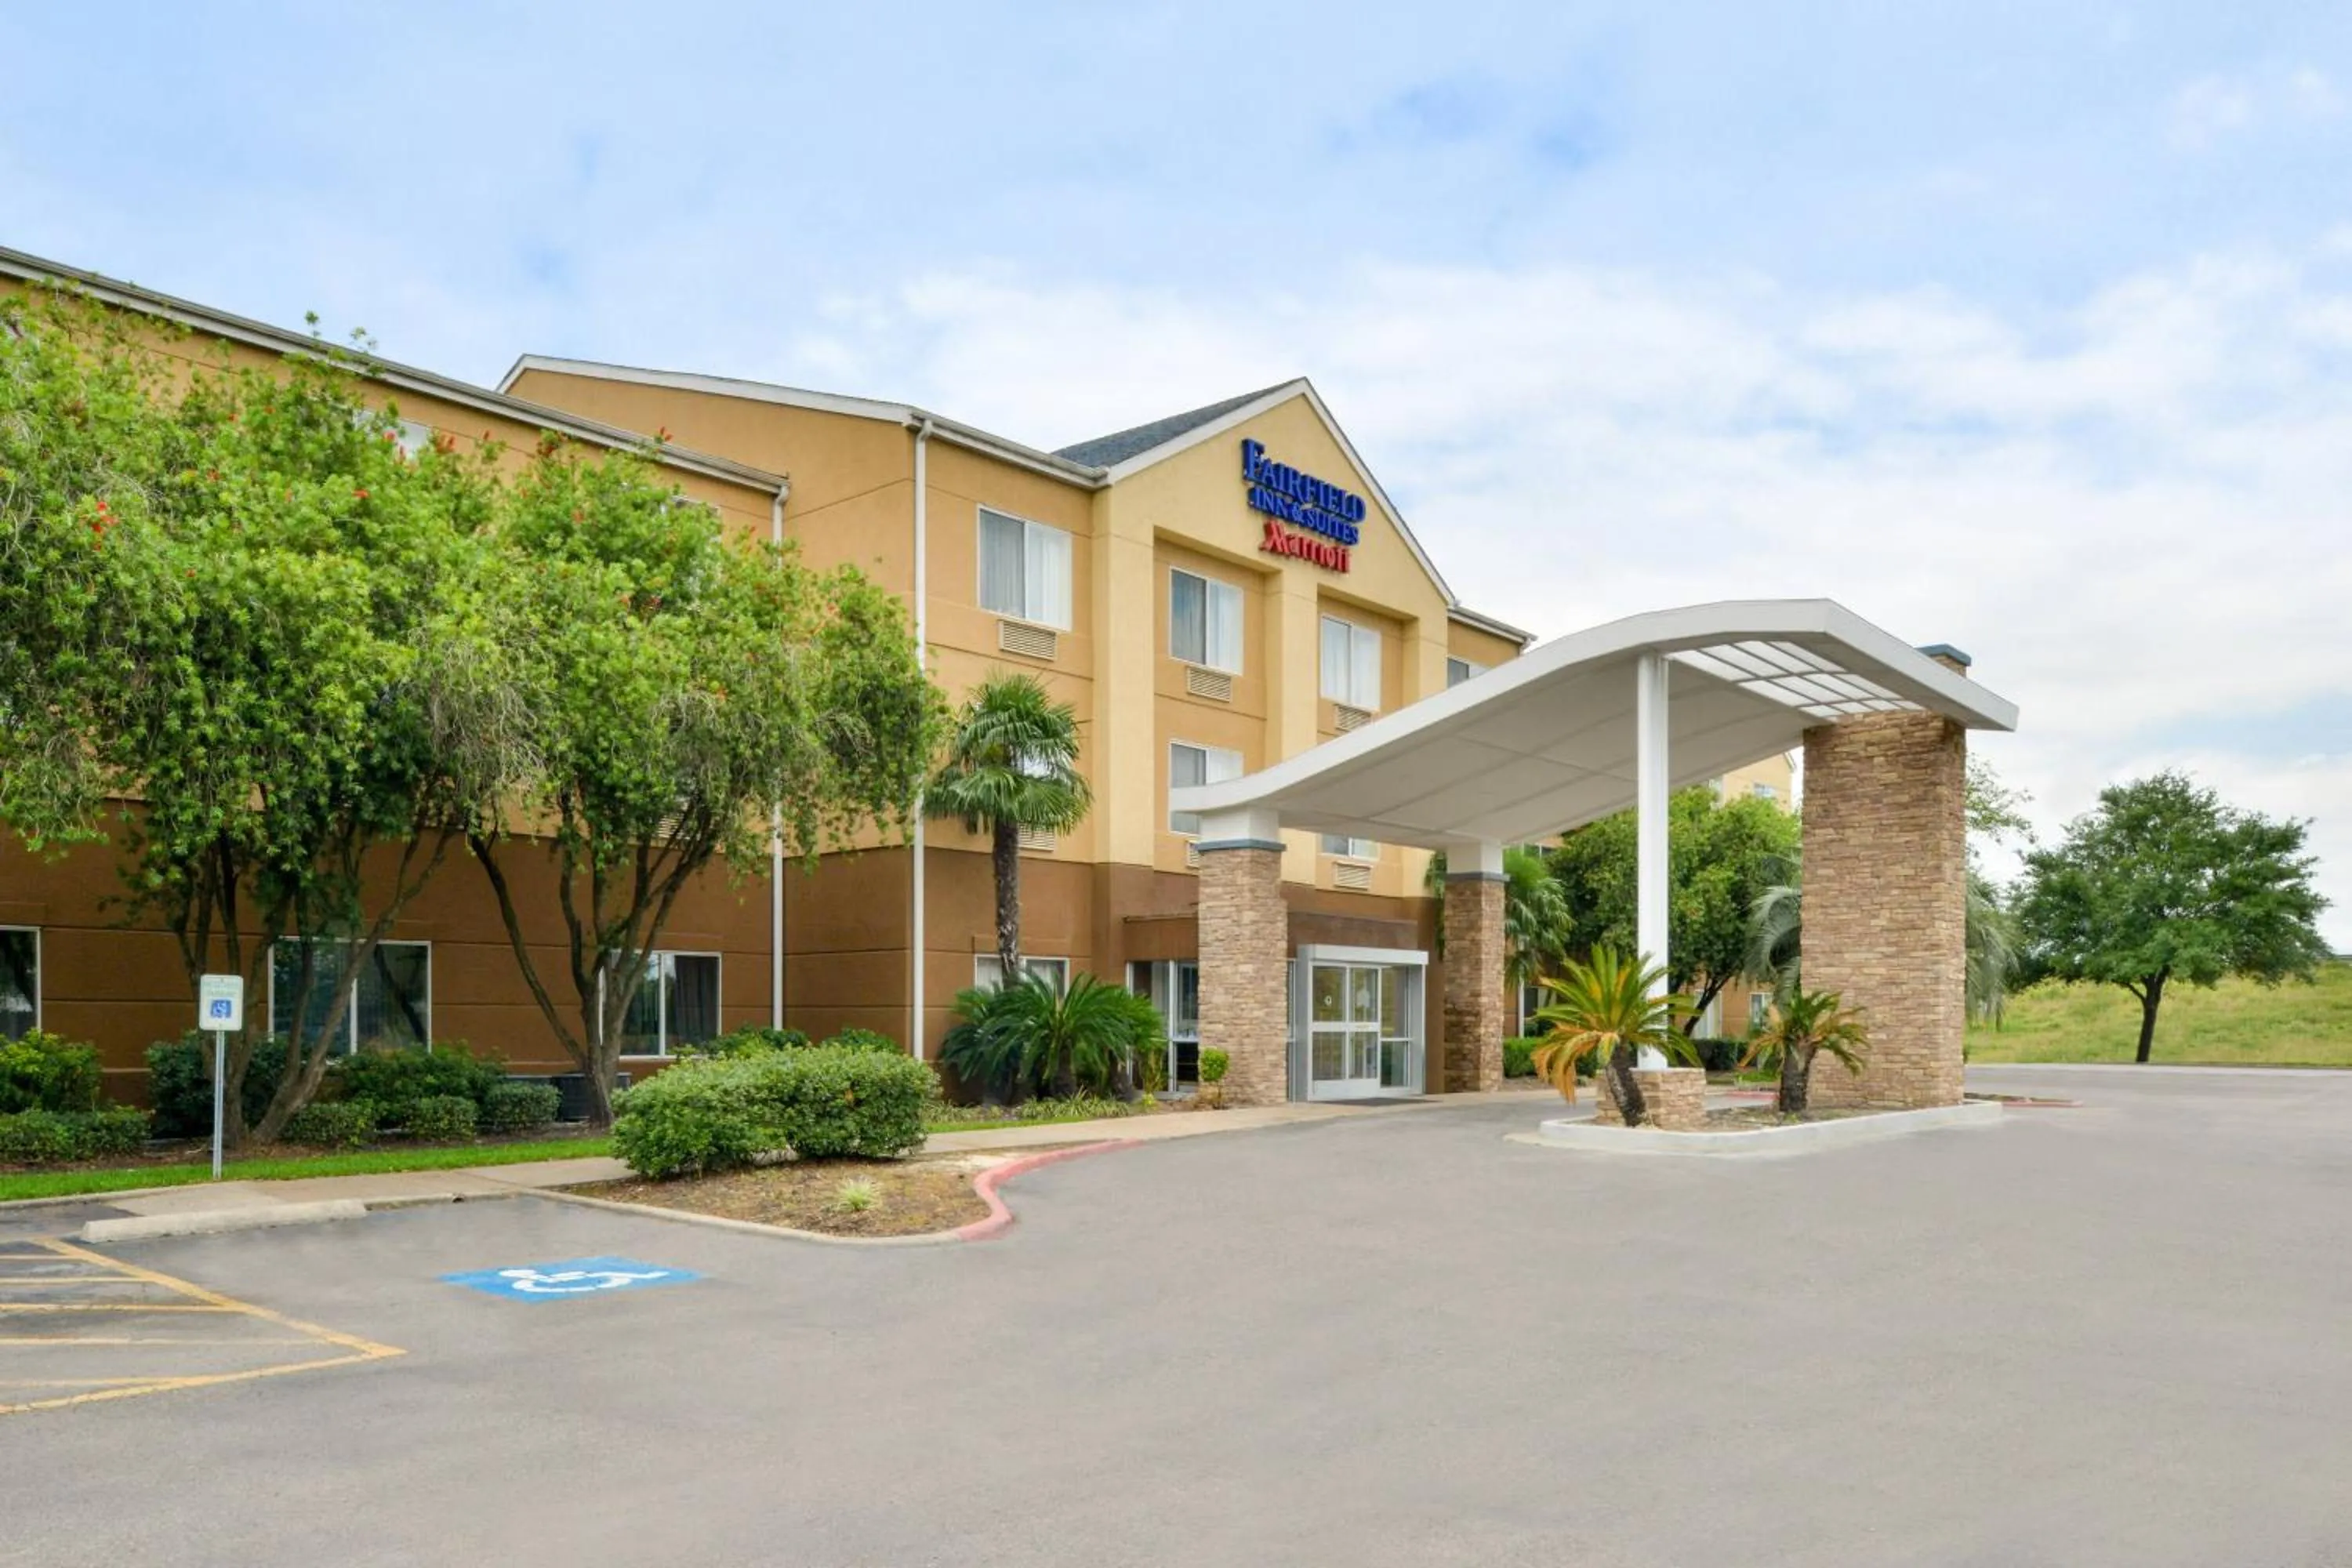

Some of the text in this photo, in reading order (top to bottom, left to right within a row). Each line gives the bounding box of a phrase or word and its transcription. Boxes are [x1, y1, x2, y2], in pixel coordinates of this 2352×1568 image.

[1243, 439, 1366, 523] FAIRFIELD
[1249, 487, 1359, 546] INN & SUITES
[1258, 517, 1351, 574] Marriott
